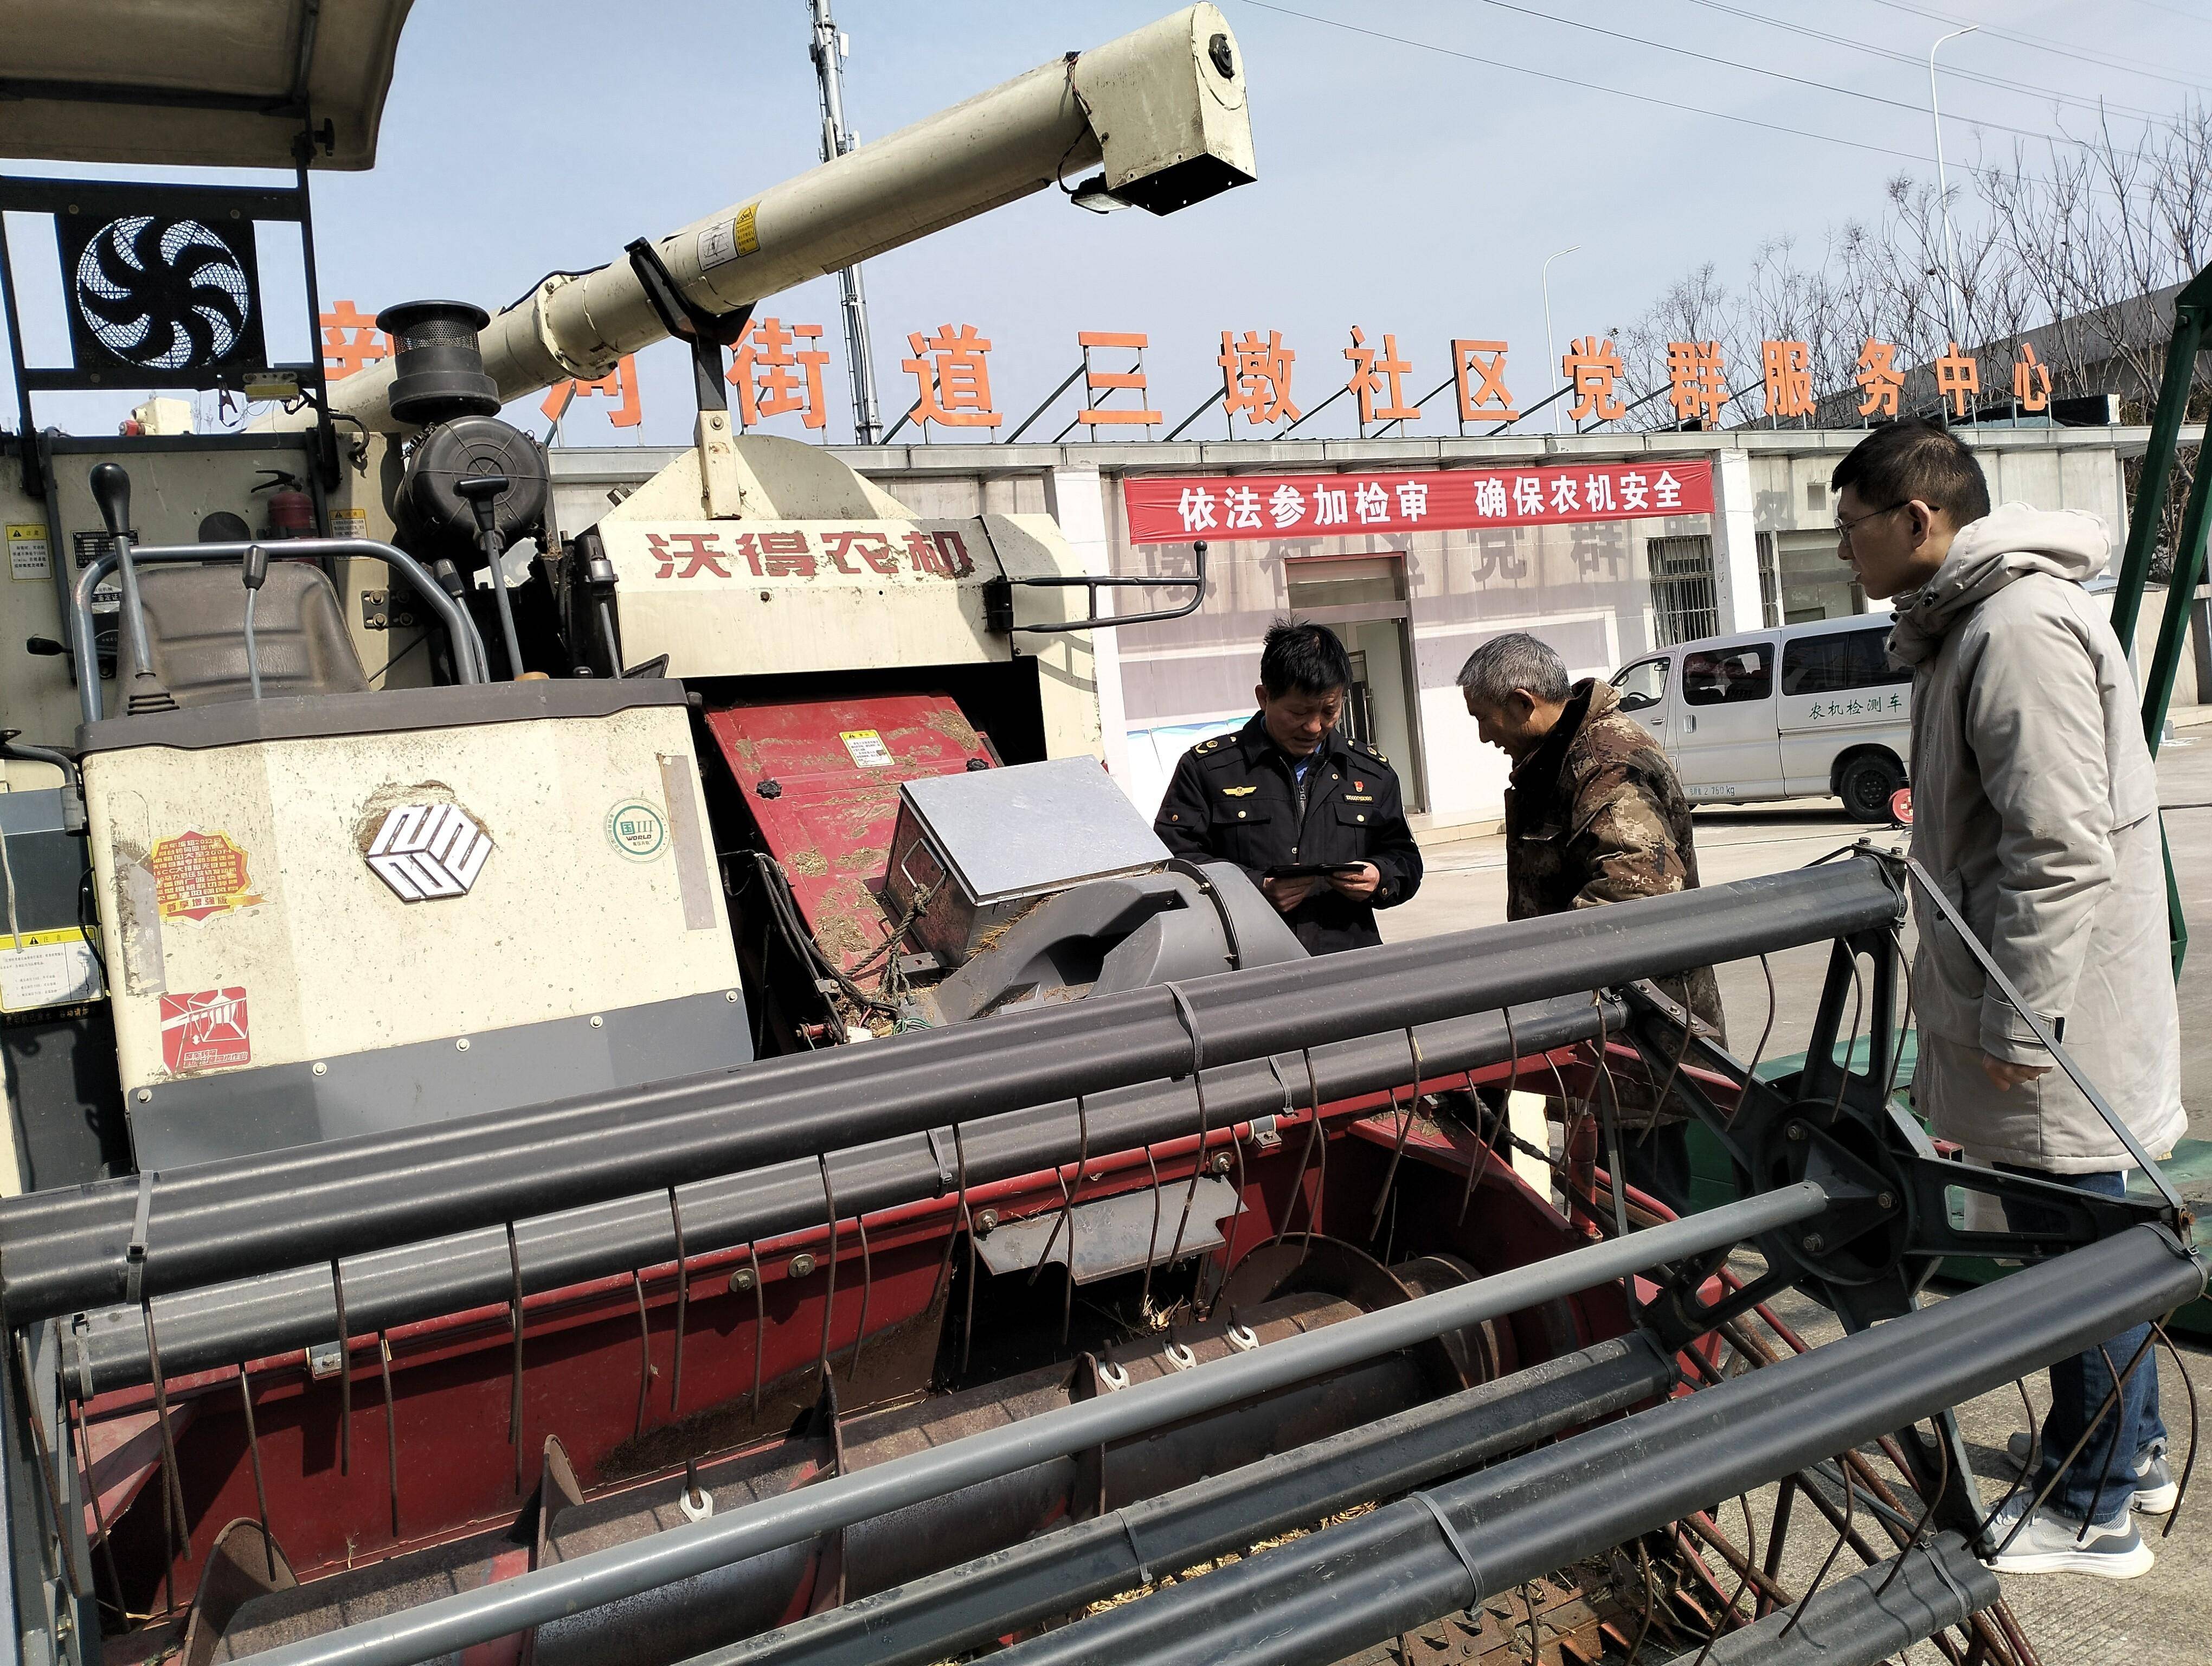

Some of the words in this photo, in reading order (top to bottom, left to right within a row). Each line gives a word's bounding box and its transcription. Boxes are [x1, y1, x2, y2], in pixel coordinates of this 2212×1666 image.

[1178, 484, 1429, 531] 依法参加检审
[1475, 470, 1683, 518] 确保农机安全
[645, 530, 975, 578] 沃得农机
[1809, 693, 1902, 720] 农机检测车
[1726, 785, 1735, 796] kg
